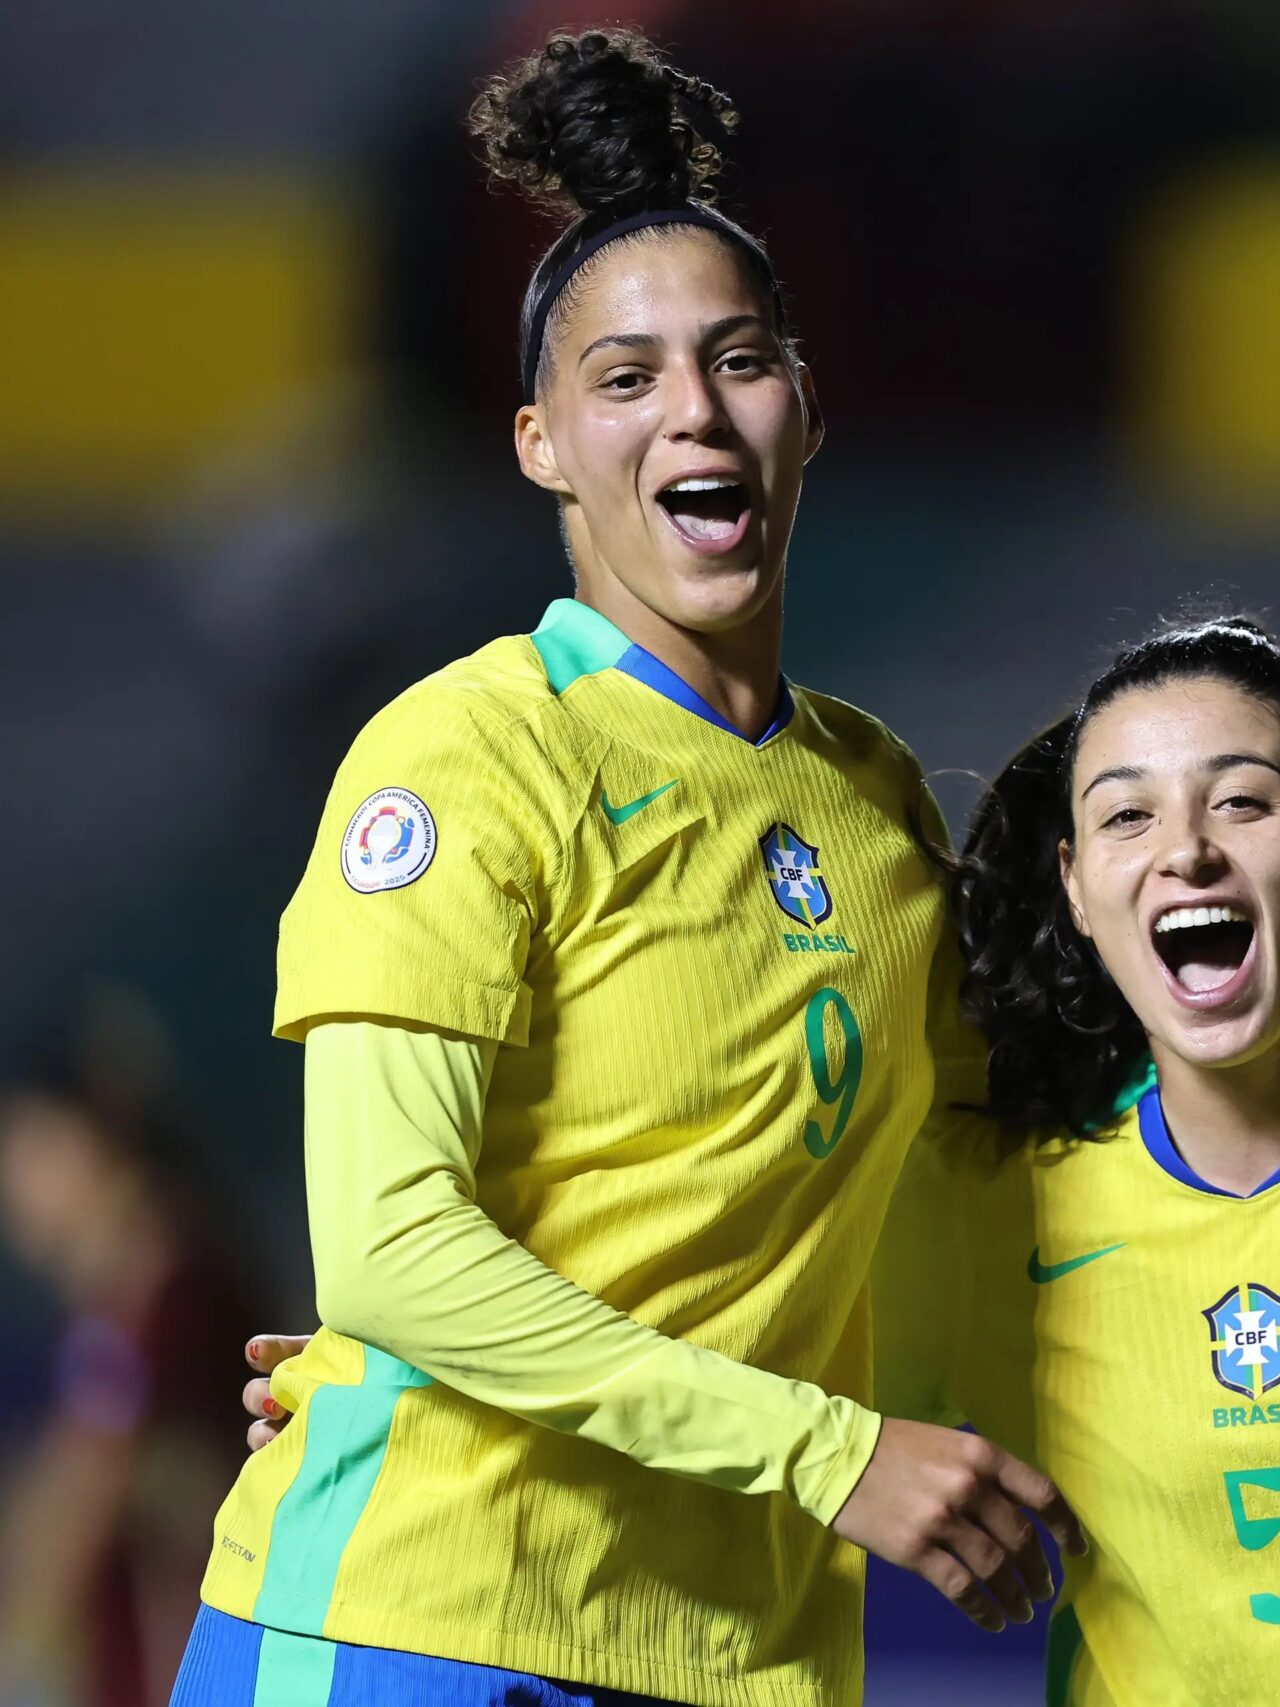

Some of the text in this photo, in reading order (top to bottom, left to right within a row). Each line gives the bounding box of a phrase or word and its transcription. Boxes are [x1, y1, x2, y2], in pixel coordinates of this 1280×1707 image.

[416, 808, 432, 850] FEMENINA
[780, 867, 804, 881] CBF
[783, 933, 856, 953] BRASIL
[803, 987, 863, 1160] 9
[1234, 1330, 1267, 1346] CBF
